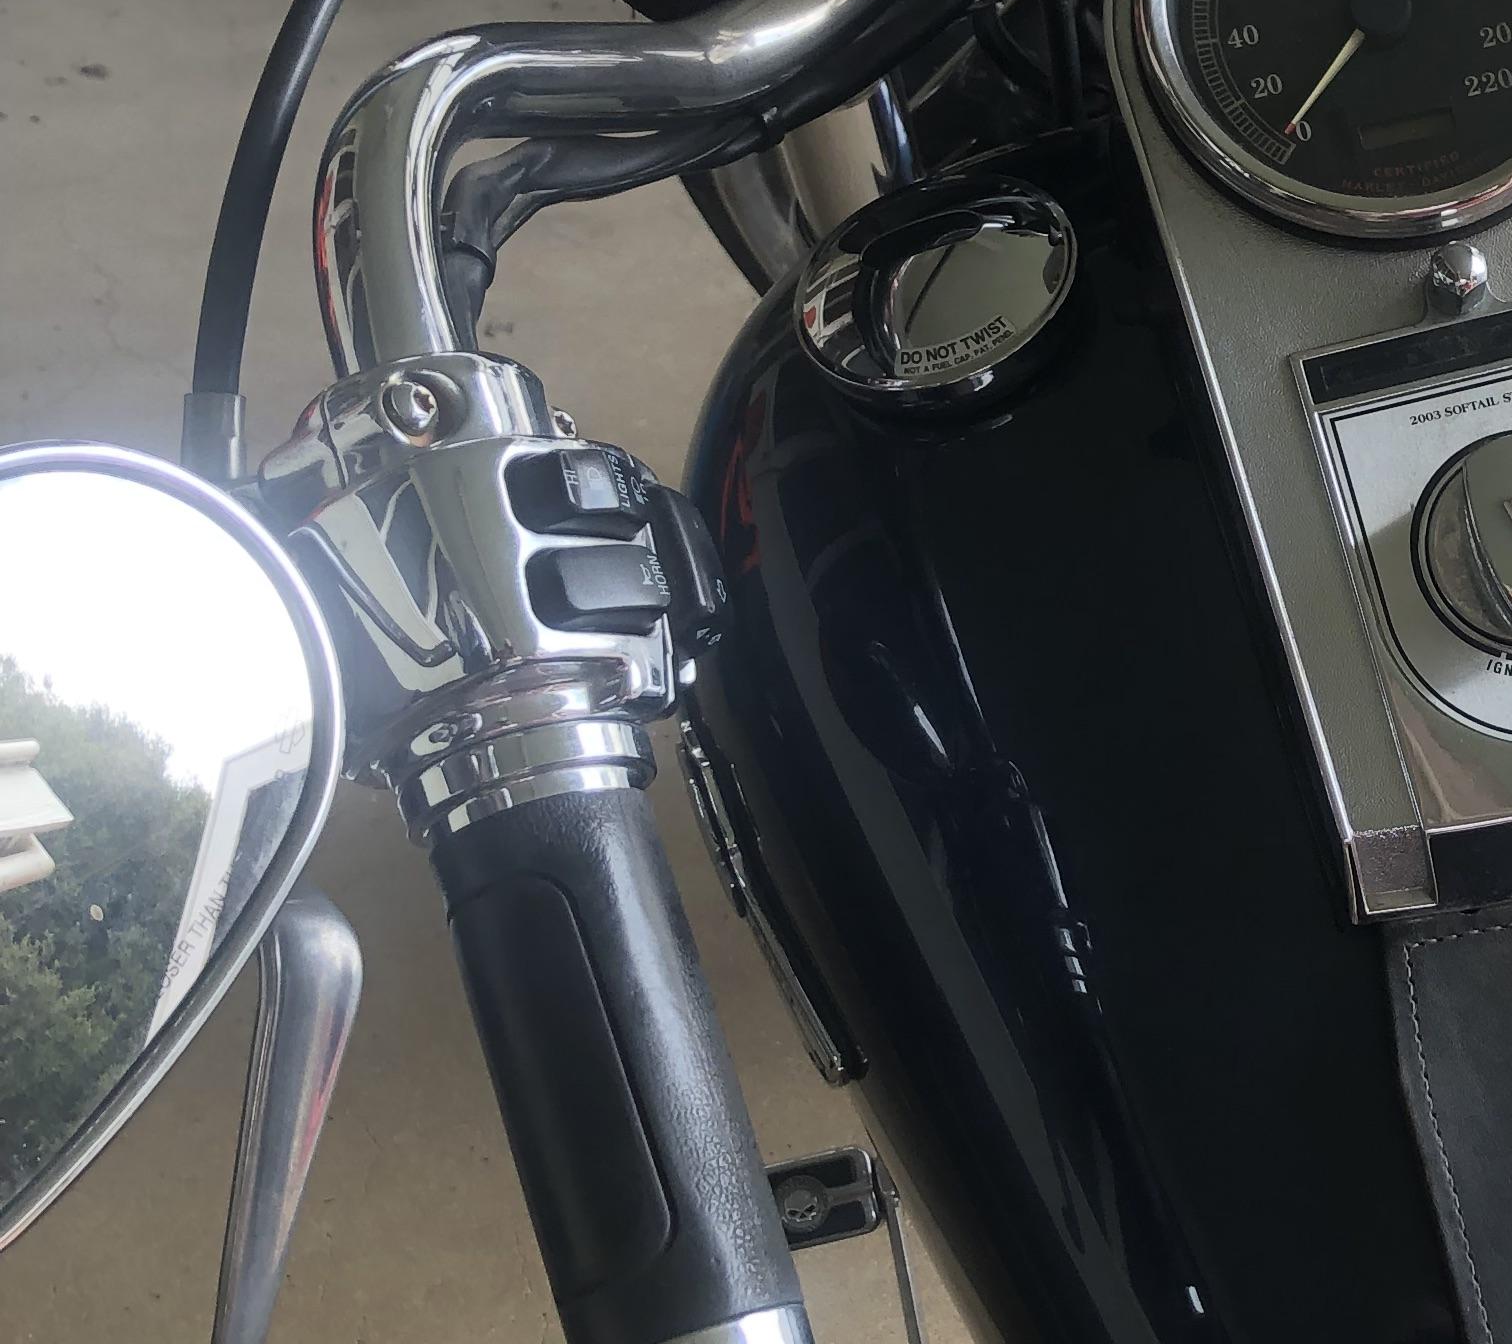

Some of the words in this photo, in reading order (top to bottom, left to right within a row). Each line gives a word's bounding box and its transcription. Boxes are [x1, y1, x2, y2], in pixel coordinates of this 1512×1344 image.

[1227, 24, 1260, 49] 40
[1250, 74, 1283, 99] 20
[1296, 121, 1312, 142] 0
[901, 351, 922, 364] DO
[926, 342, 957, 362] NOT
[960, 316, 1007, 350] TWIST
[1409, 409, 1442, 426] 2003
[1443, 395, 1500, 419] SOFTAIL
[608, 454, 631, 508] LIGHTS
[647, 554, 670, 595] HORN
[187, 891, 225, 937] THAN
